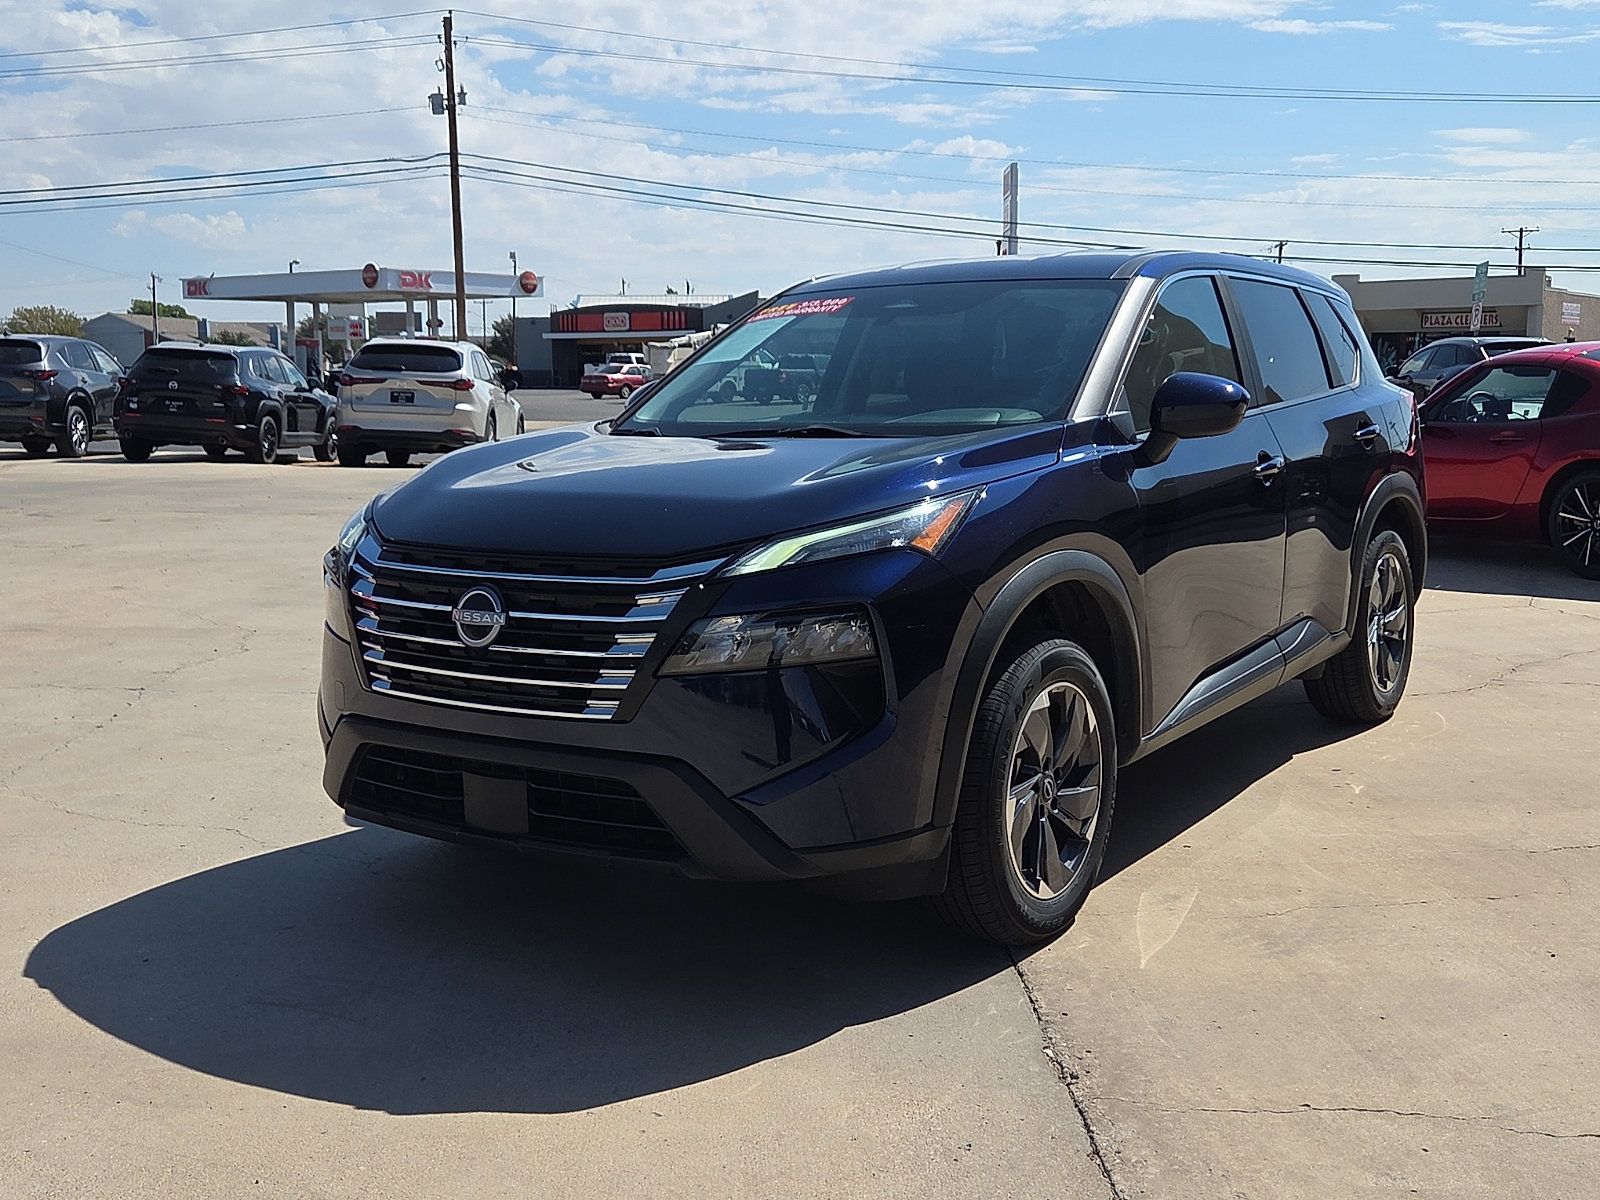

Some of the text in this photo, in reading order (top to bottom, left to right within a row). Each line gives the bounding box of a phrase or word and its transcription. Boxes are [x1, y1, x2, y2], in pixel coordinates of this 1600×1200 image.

[400, 270, 434, 289] DK
[1424, 314, 1499, 326] PLAZA CLEERS
[452, 609, 504, 623] NISSAN
